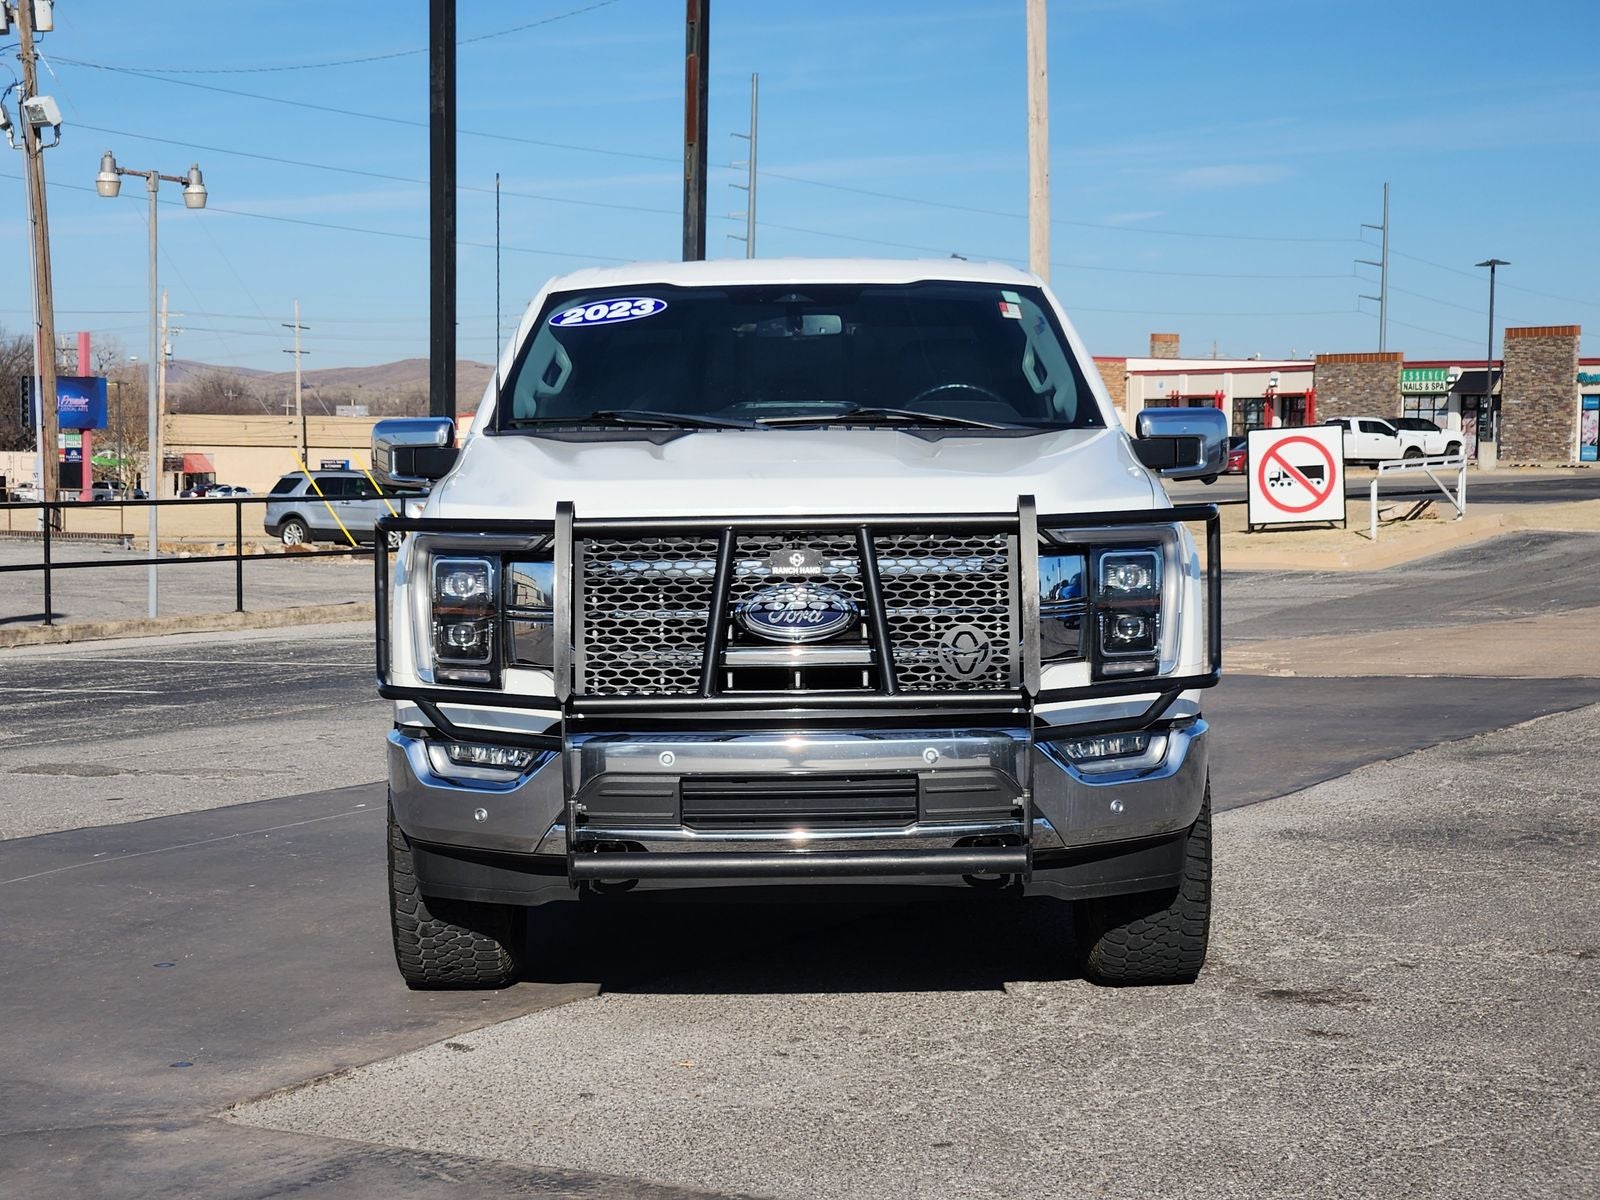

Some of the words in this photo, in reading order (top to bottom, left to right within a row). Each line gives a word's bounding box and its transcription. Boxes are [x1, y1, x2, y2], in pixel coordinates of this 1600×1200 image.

[560, 299, 655, 325] 2023
[1403, 371, 1445, 380] ESSENCE
[1404, 382, 1423, 390] NAILS
[1425, 382, 1429, 390] &
[1431, 382, 1444, 390] SPA
[800, 566, 821, 574] HAND
[768, 601, 825, 624] Ford
